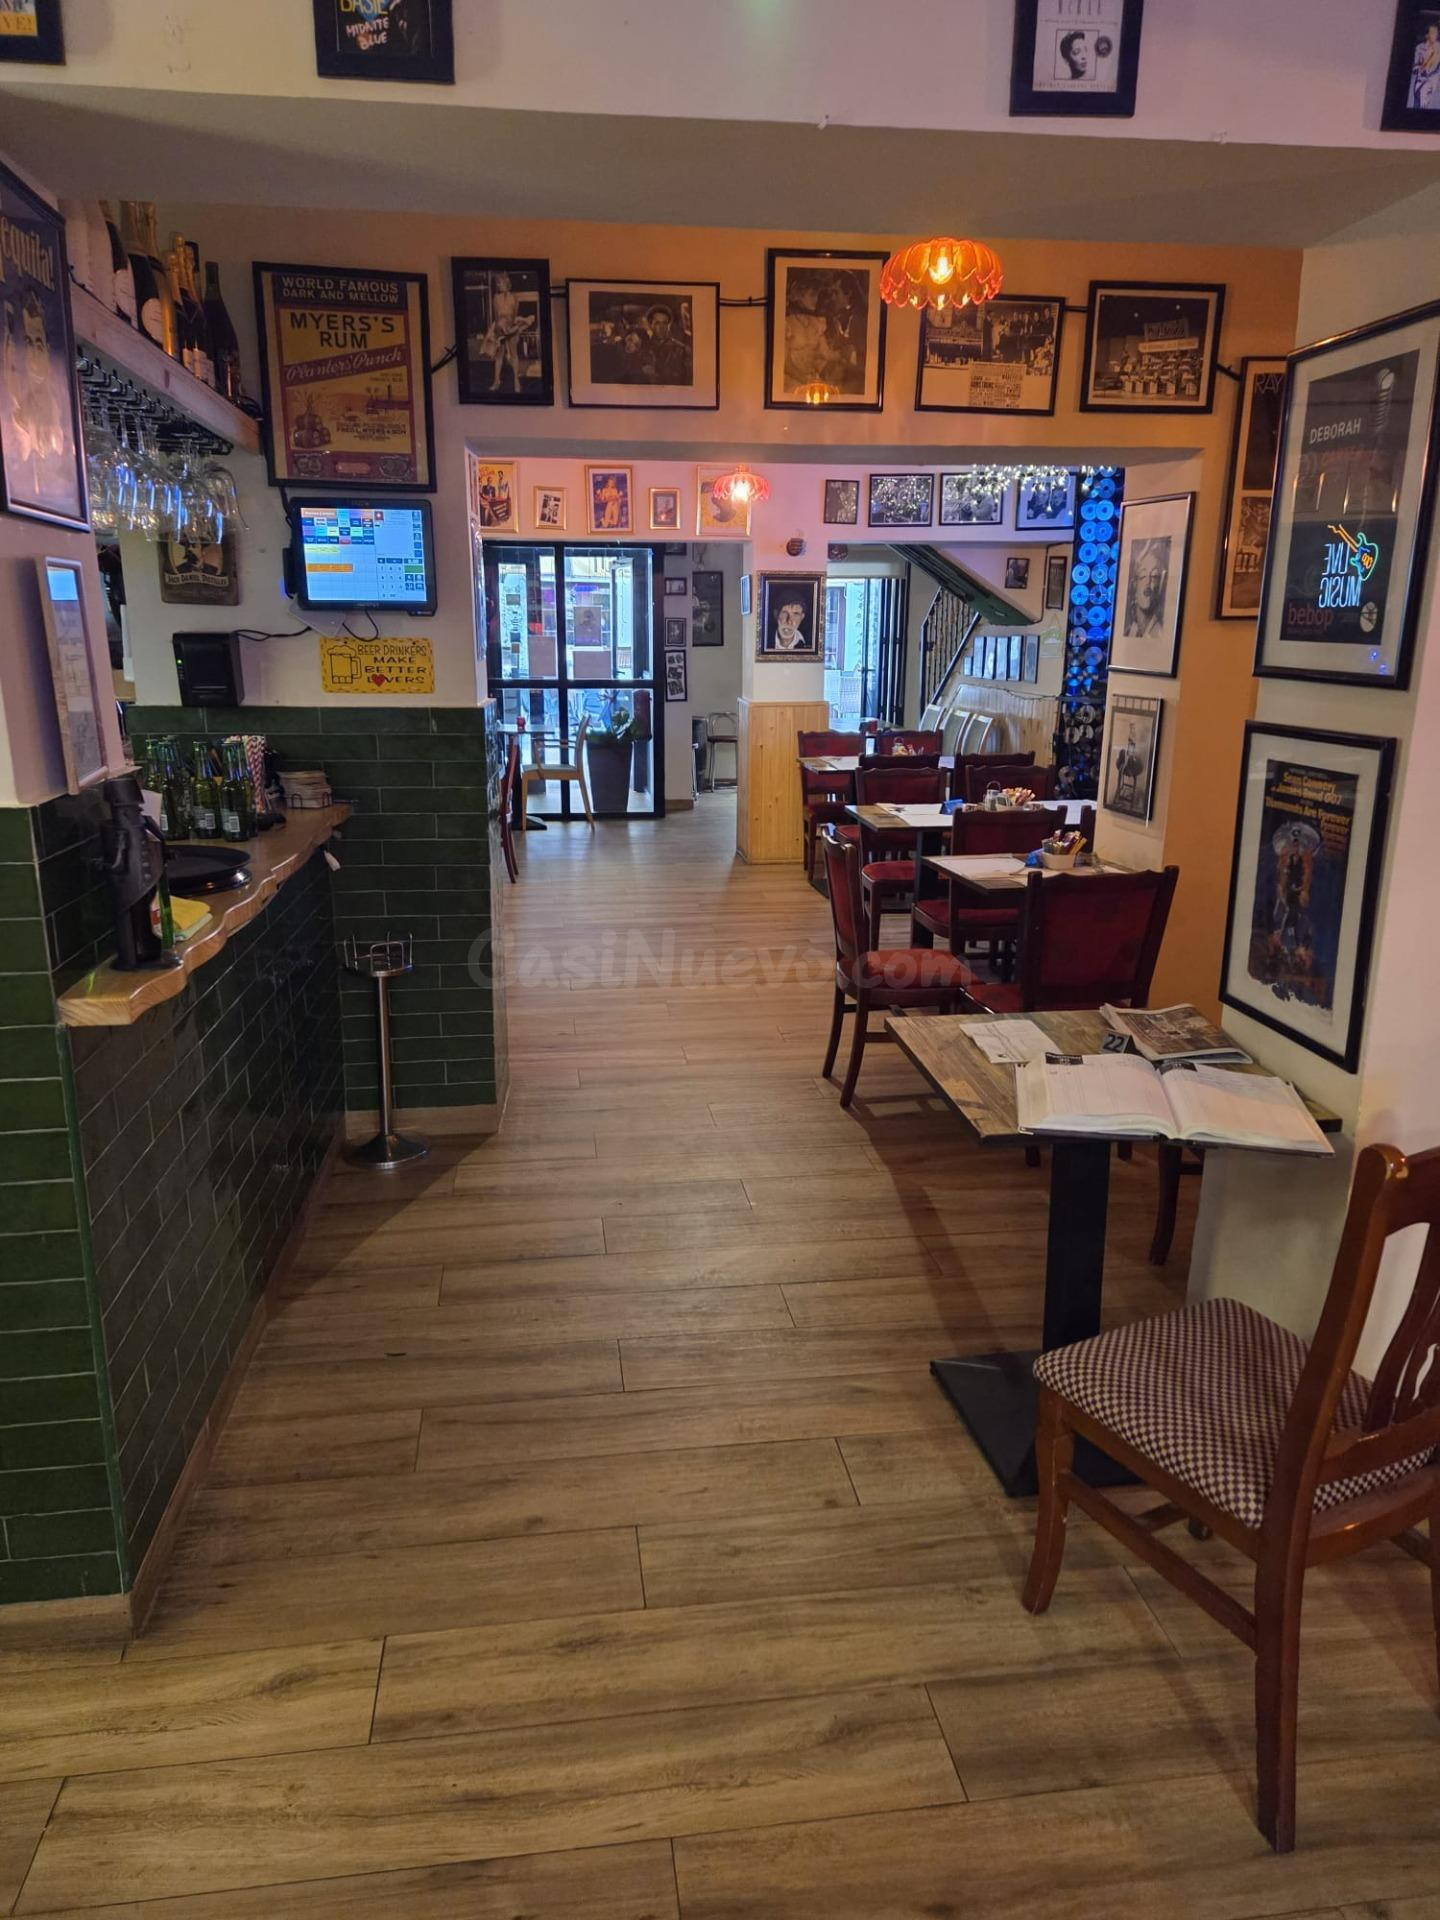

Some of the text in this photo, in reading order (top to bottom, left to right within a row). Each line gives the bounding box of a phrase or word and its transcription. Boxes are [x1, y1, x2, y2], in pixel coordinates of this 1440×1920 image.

[359, 31, 388, 50] BLUE
[0, 216, 57, 292] equila!
[282, 276, 399, 294] WORLD FAMOUS
[282, 288, 399, 304] DARK AND MELLOW
[290, 312, 396, 333] MYERS'S
[319, 331, 369, 349] RUM
[1255, 373, 1285, 394] RAY
[1309, 417, 1362, 445] DEBORAH
[1287, 602, 1335, 632] bebop
[357, 644, 427, 657] BEER DRINKERS
[373, 656, 417, 664] MAKE
[364, 665, 428, 674] BETTER
[1103, 1033, 1125, 1053] 22
